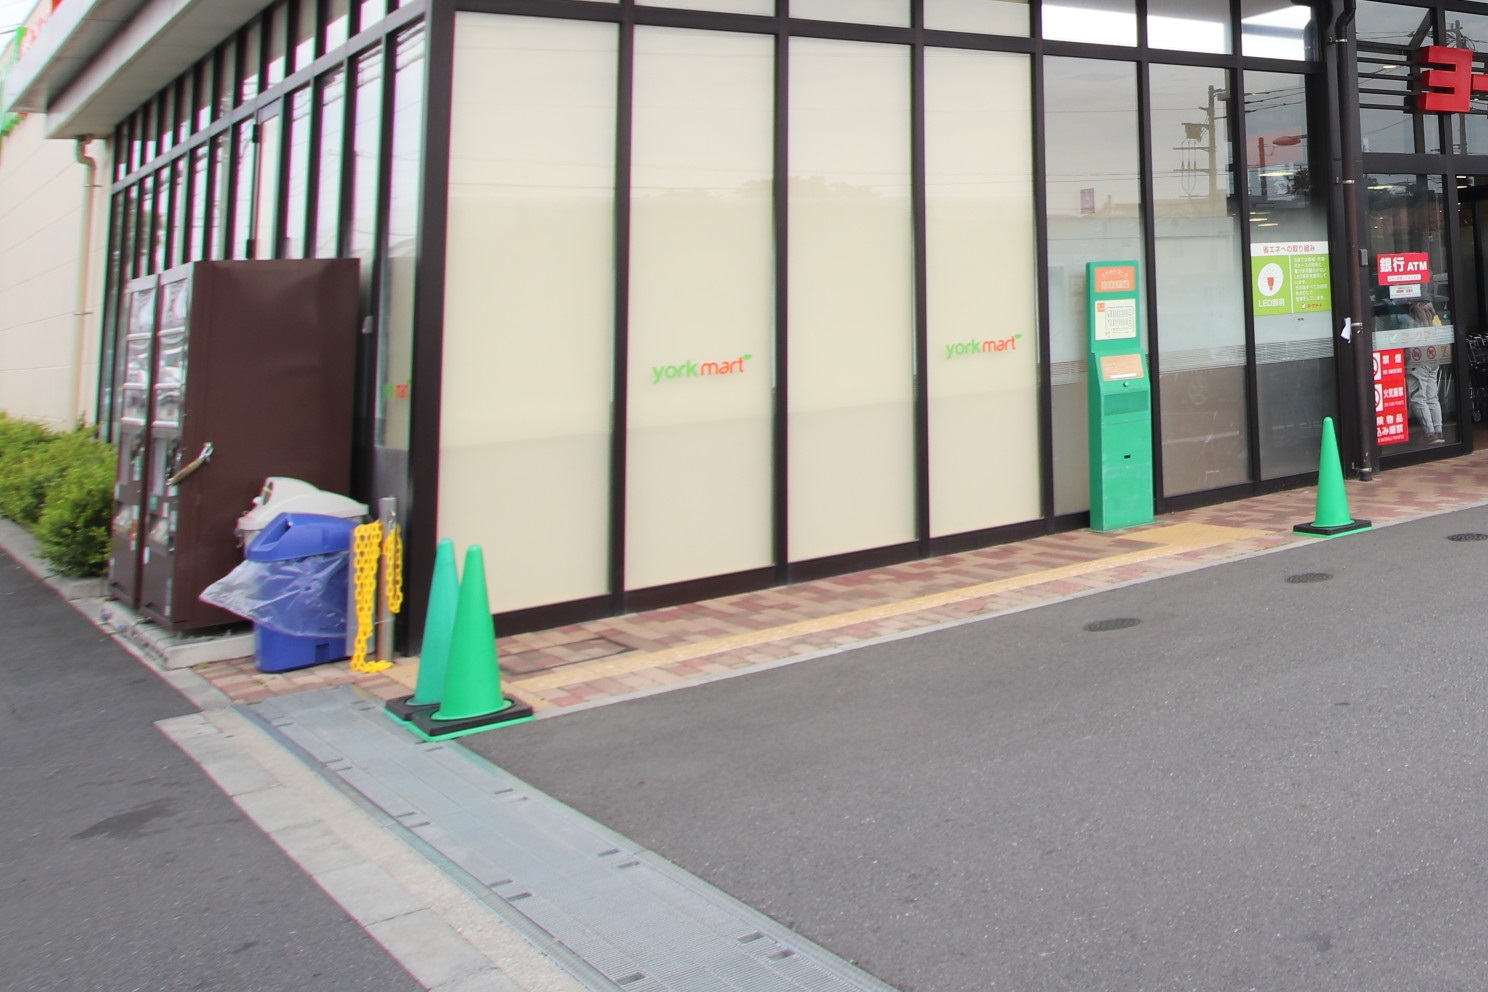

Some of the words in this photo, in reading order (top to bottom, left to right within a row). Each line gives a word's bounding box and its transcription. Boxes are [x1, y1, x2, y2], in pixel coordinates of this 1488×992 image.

[1263, 244, 1316, 254] 省エネへの取り組み
[1379, 256, 1405, 273] 銀行
[1406, 260, 1428, 272] ATM
[1258, 298, 1285, 308] LED照明
